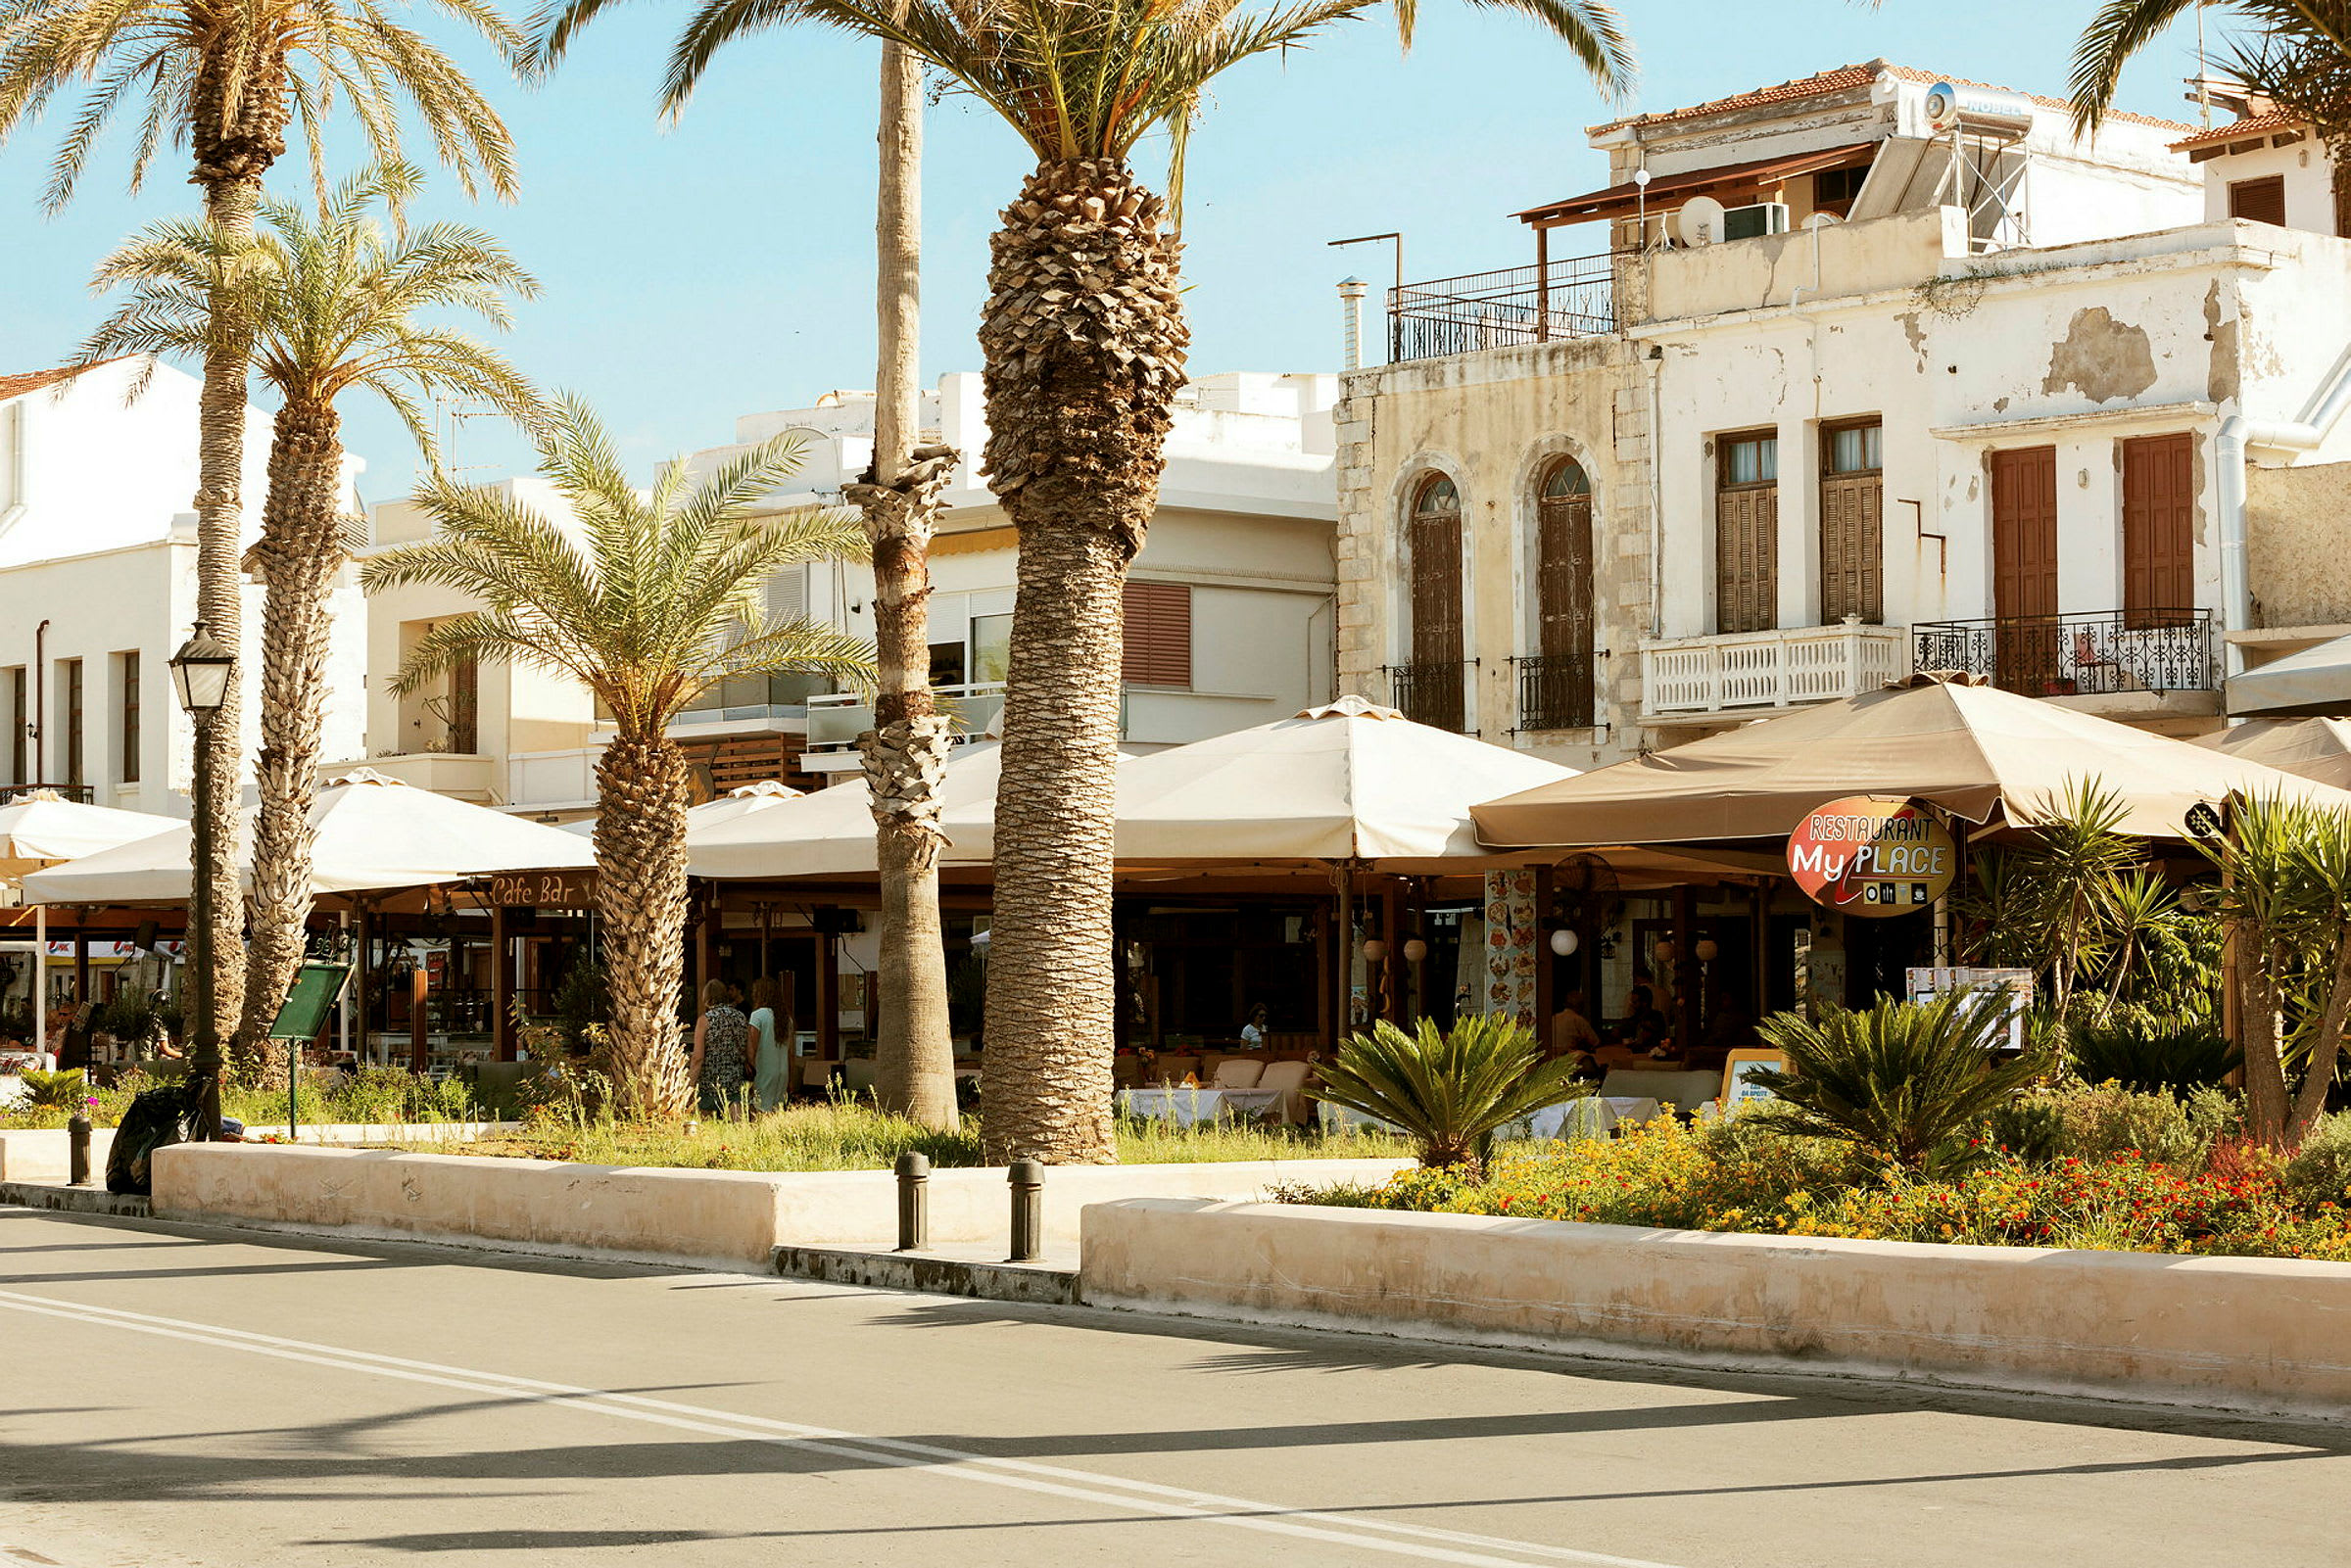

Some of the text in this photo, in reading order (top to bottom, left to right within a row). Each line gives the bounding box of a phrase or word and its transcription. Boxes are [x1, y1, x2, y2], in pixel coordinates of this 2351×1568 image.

[1809, 815, 1934, 841] RESTAURANT
[1792, 844, 1946, 881] My PLACE
[493, 876, 576, 905] Cafe Bar
